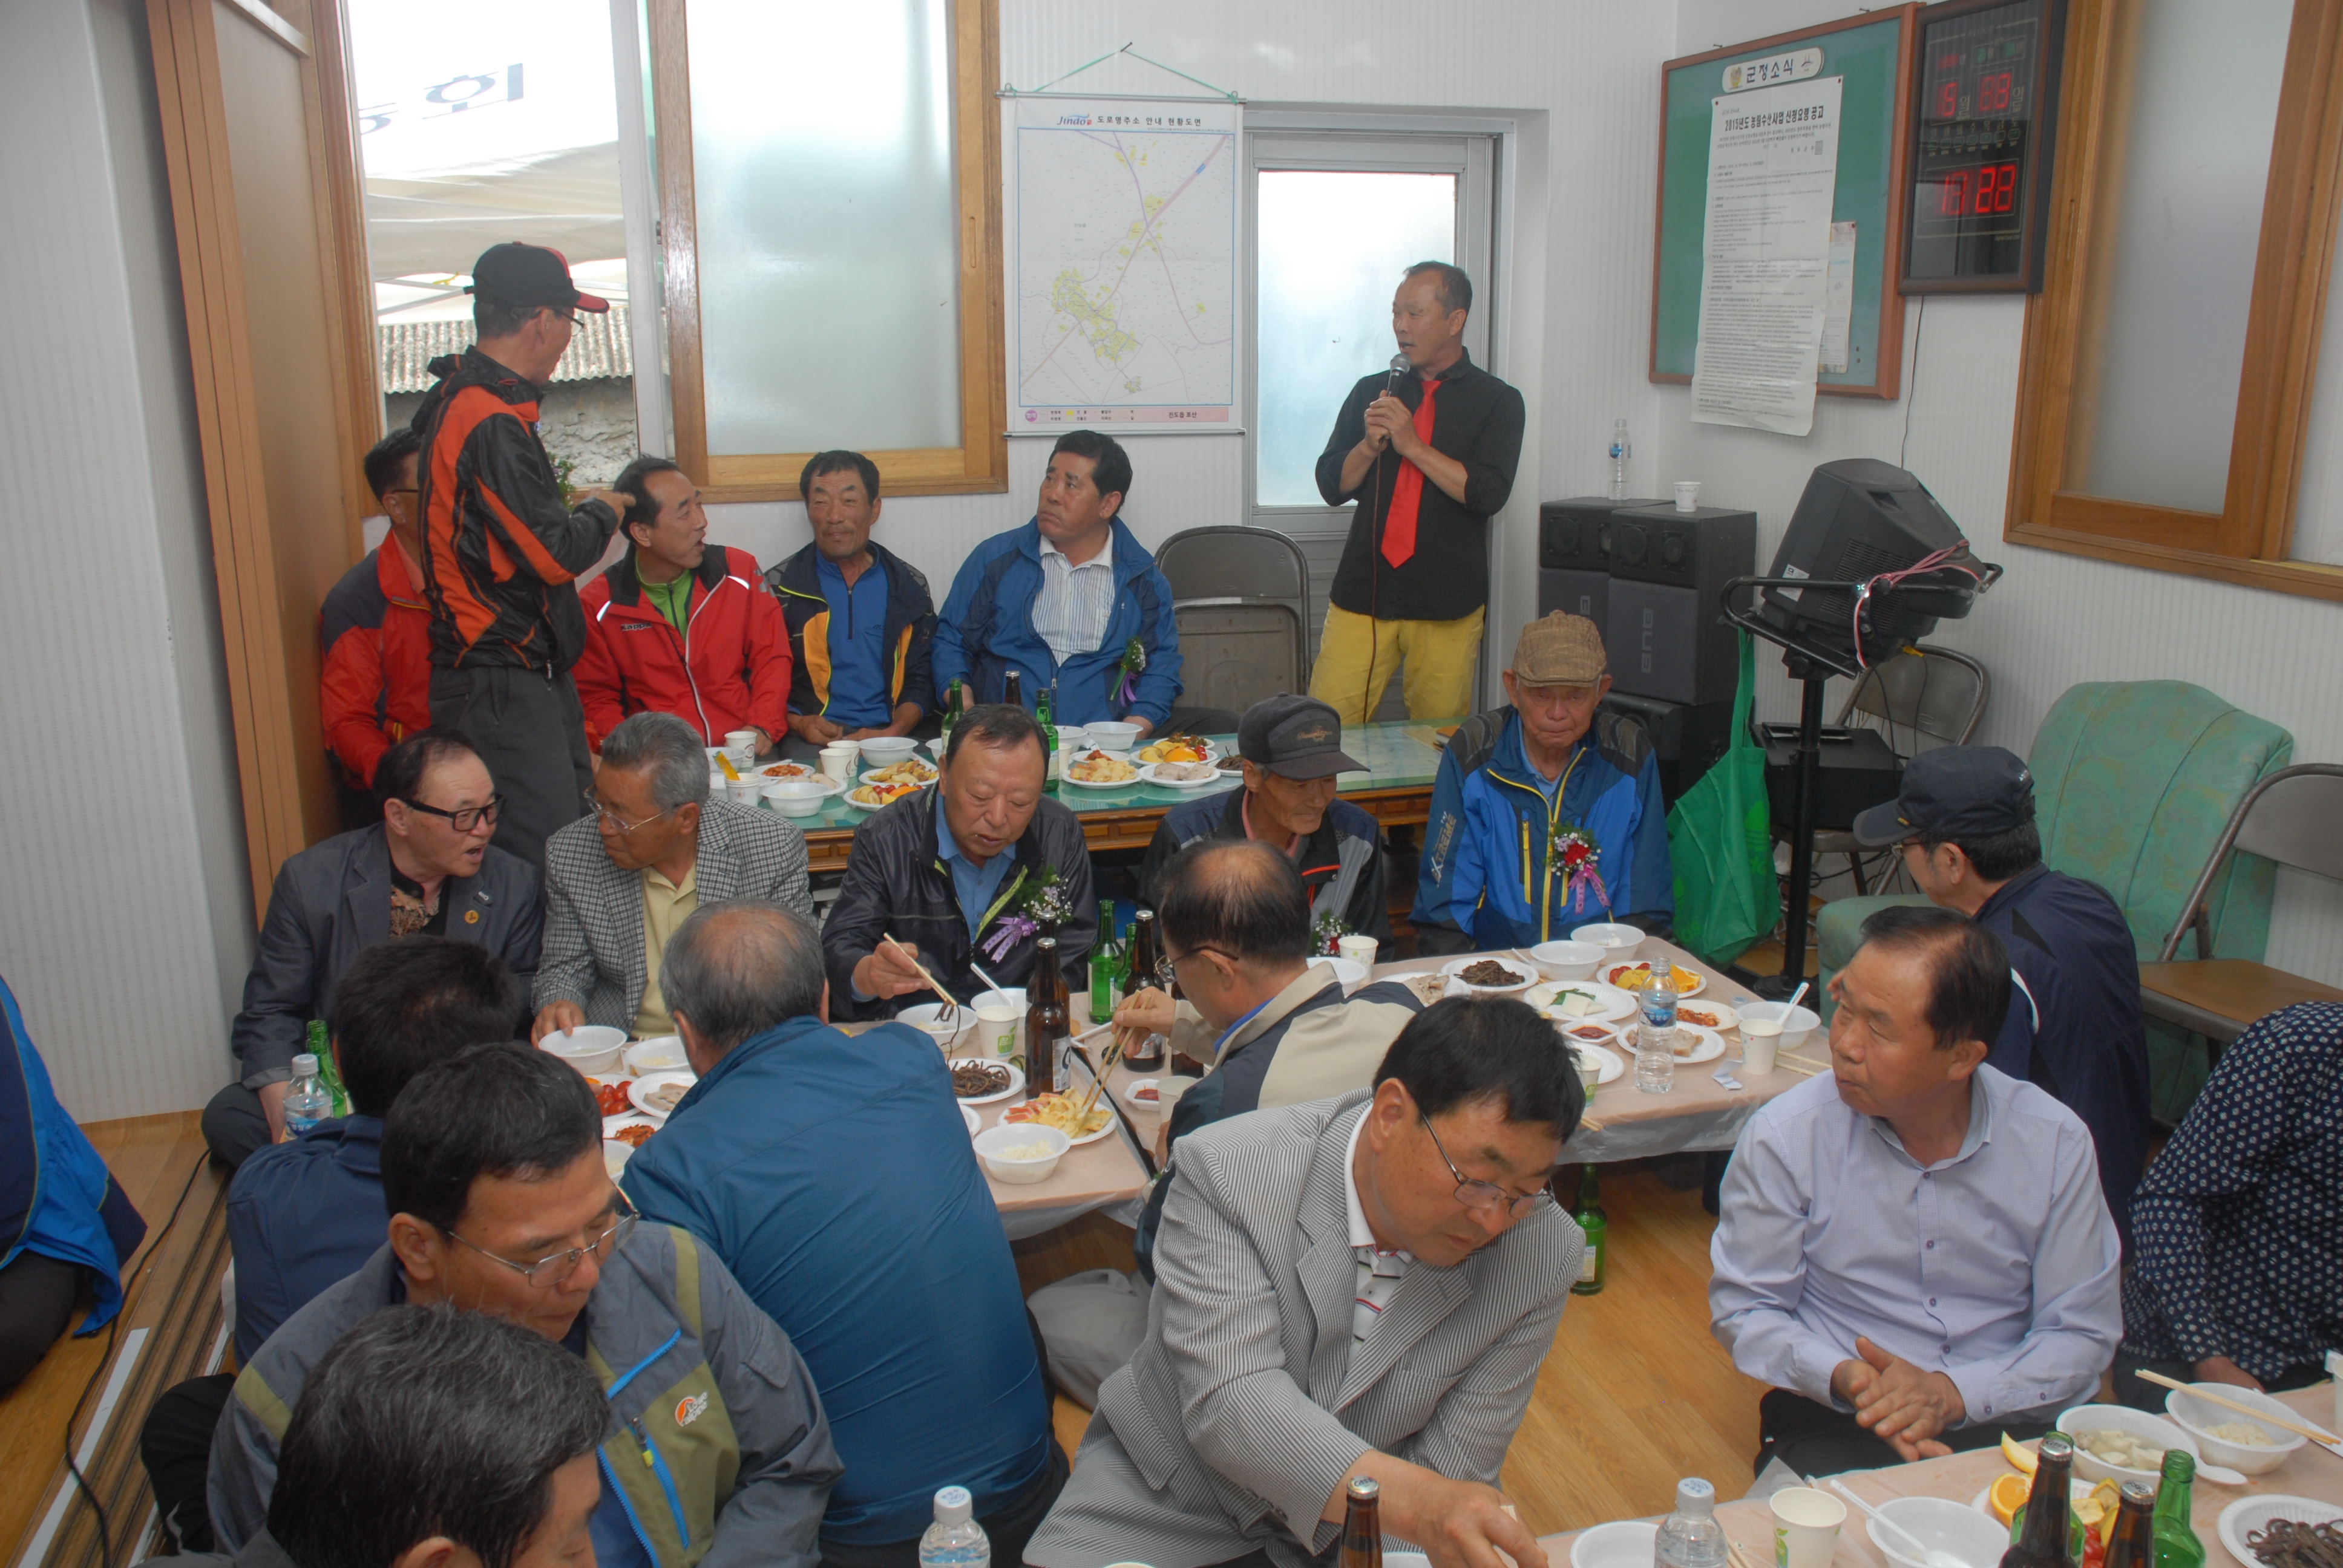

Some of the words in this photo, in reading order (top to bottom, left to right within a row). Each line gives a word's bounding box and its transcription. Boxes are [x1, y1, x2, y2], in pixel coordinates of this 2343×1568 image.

[1746, 58, 1794, 83] 군정소식
[2012, 87, 2025, 108] 일
[1057, 115, 1087, 126] Jindo
[1097, 116, 1141, 125] 도로명주소
[1145, 117, 1162, 125] 안내
[1168, 118, 1202, 126] 현황도면
[1725, 116, 1749, 132] 2015년도
[1751, 111, 1784, 128] 농림수산사업
[1786, 107, 1810, 123] 신청요령
[1811, 105, 1824, 120] 공고
[621, 622, 652, 631] Kappa
[686, 1392, 708, 1413] Lowe
[1354, 1477, 1374, 1488] Cass
